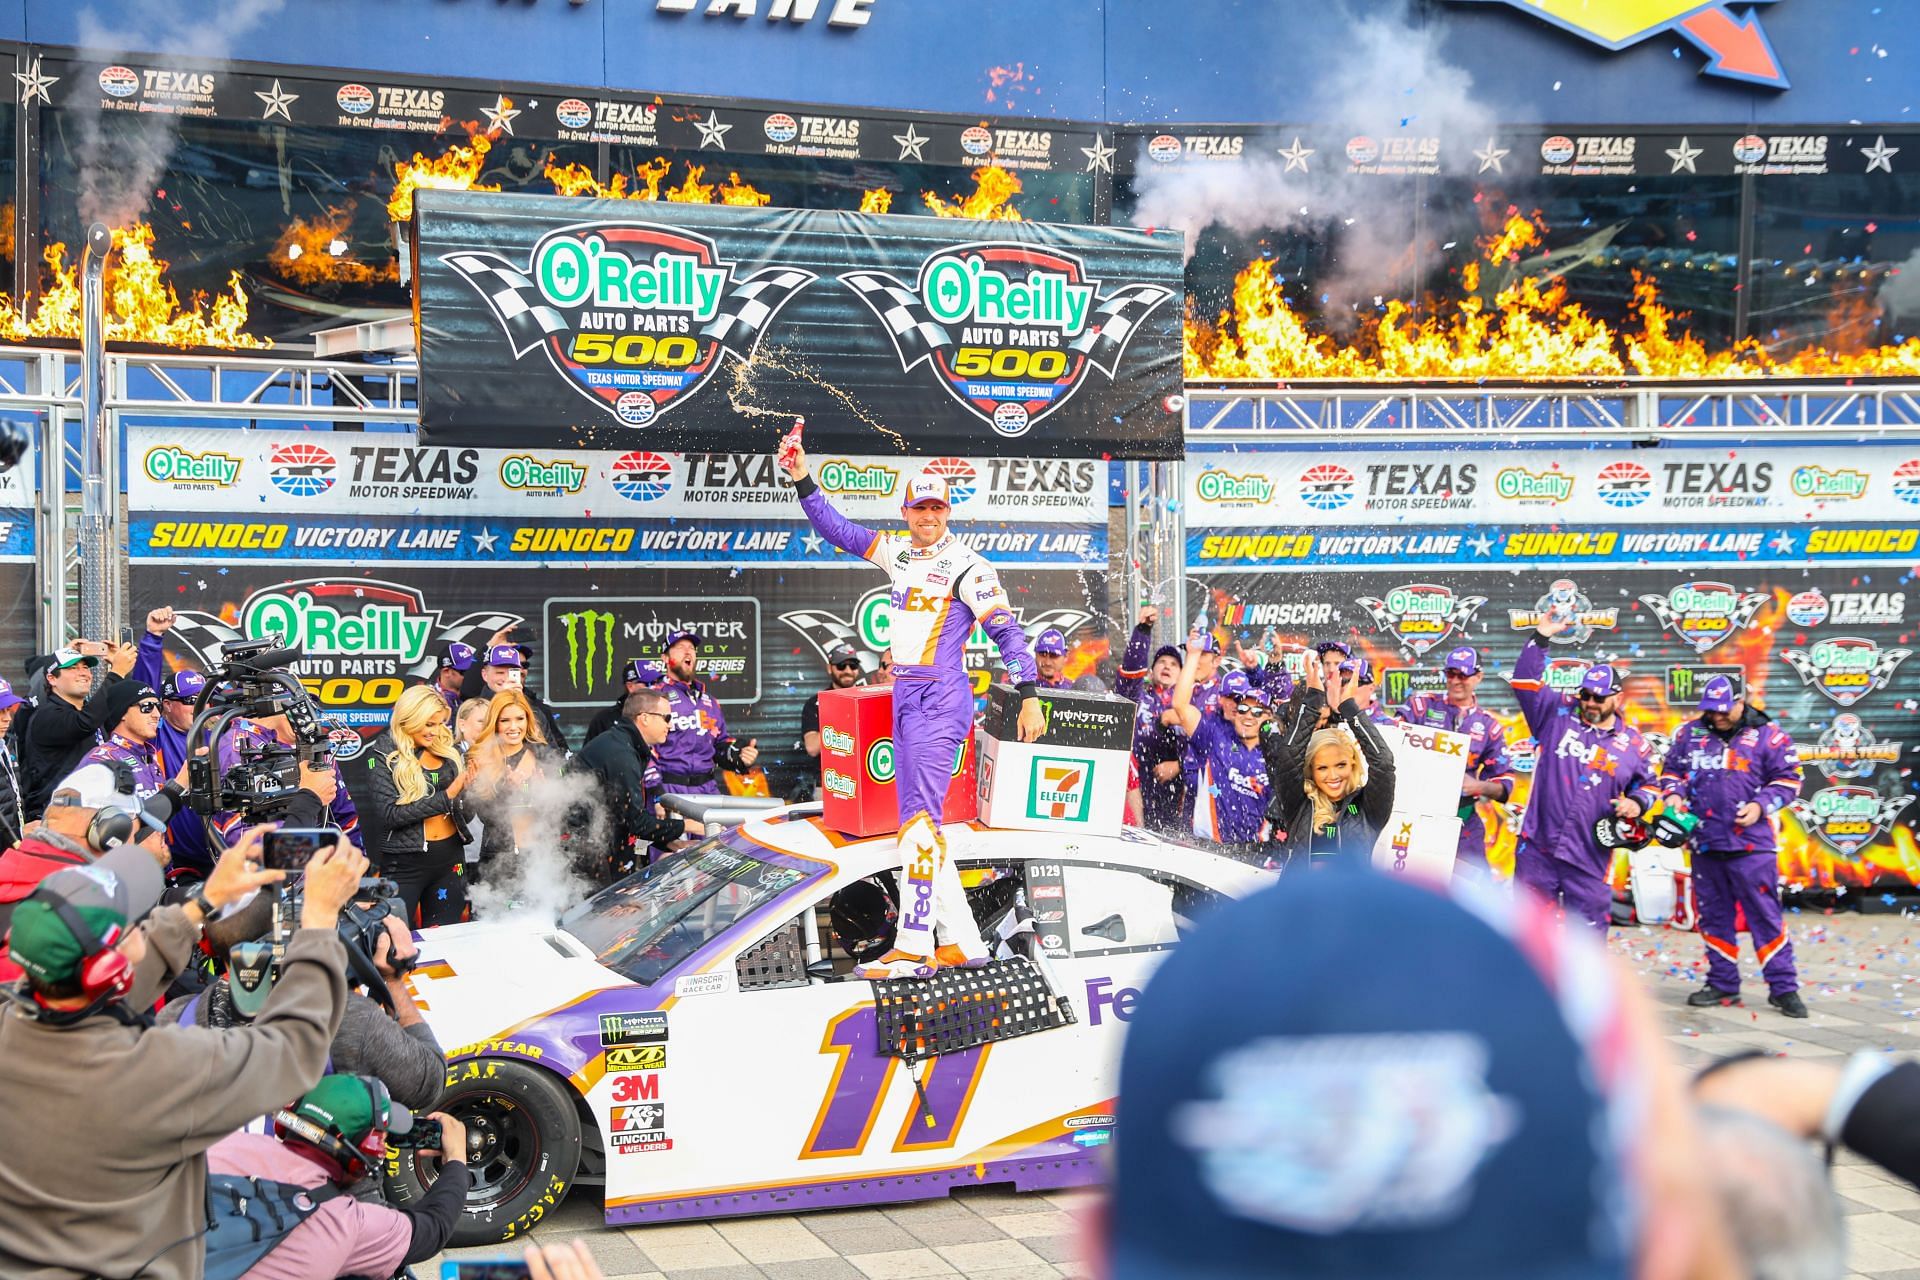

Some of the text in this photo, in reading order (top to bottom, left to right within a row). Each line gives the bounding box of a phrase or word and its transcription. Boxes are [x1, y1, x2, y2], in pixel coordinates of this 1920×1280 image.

[143, 69, 214, 94] TEXAS
[378, 87, 445, 111] TEXAS
[377, 107, 441, 118] MOTOR SPEEDWAY
[595, 101, 657, 124] TEXAS
[800, 116, 860, 138] TEXAS
[995, 129, 1051, 151] TEXAS
[1184, 136, 1243, 155] TEXAS
[1382, 137, 1440, 156] TEXAS
[1576, 136, 1636, 156] TEXAS
[1768, 135, 1828, 155] TEXAS
[541, 241, 721, 316] O'Reilly
[927, 260, 1087, 332] O'Reilly
[580, 312, 690, 333] AUTO PARTS
[962, 327, 1060, 347] AUTO PARTS
[572, 333, 698, 366] 500
[955, 348, 1067, 378] 500
[587, 372, 683, 388] TEXAS MOTOR SPEEDWAY
[967, 384, 1053, 398] TEXAS MOTOR SPEEDWAY
[149, 449, 240, 485] O'Reilly
[349, 447, 479, 485] TEXAS
[504, 457, 585, 490] O'Reilly
[987, 458, 1095, 492] TEXAS
[173, 483, 215, 492] AUTO PARTS
[822, 461, 897, 495] O'Reilly
[1199, 472, 1272, 502] O'Reilly
[1366, 463, 1477, 495] TEXAS
[1500, 468, 1570, 499] O'Reilly
[1663, 462, 1774, 494] TEXAS
[349, 485, 474, 500] MOTOR SPEEDWAY
[683, 491, 796, 503] MOTOR SPEEDWAY
[988, 494, 1091, 507] MOTOR SPEEDWAY
[1663, 496, 1770, 508] MOTOR SPEEDWAY
[1366, 499, 1473, 510] MOTOR SPEEDWAY
[149, 522, 460, 549] SUNOCO VICTORY LANE
[510, 527, 791, 552] SUNOCO VICTORY LANE
[1038, 533, 1092, 552] LANE
[1621, 533, 1707, 553] VICTORY
[1709, 533, 1764, 552] LANE
[1805, 529, 1919, 553] SUNOCO
[1200, 535, 1462, 559] SUNOCO VICTORY LANE
[1251, 603, 1332, 625] NASCAR
[1390, 592, 1452, 614] O'Reilly
[1829, 592, 1906, 616] TEXAS
[1399, 620, 1445, 632] 500
[288, 658, 396, 675] AUTO PARTS
[708, 659, 746, 672] SERIES
[349, 711, 390, 723] SPEEDWAY
[1053, 709, 1114, 725] MONSTER
[1689, 748, 1751, 772] FedEx
[1044, 767, 1081, 818] 7
[1030, 865, 1060, 878] D129
[903, 843, 934, 932] FedEx
[683, 983, 722, 994] RACE CAR
[623, 1016, 665, 1026] MONSTER
[612, 1074, 659, 1102] 3M
[613, 1132, 663, 1146] LINCOLN
[623, 1141, 667, 1153] WELDERS
